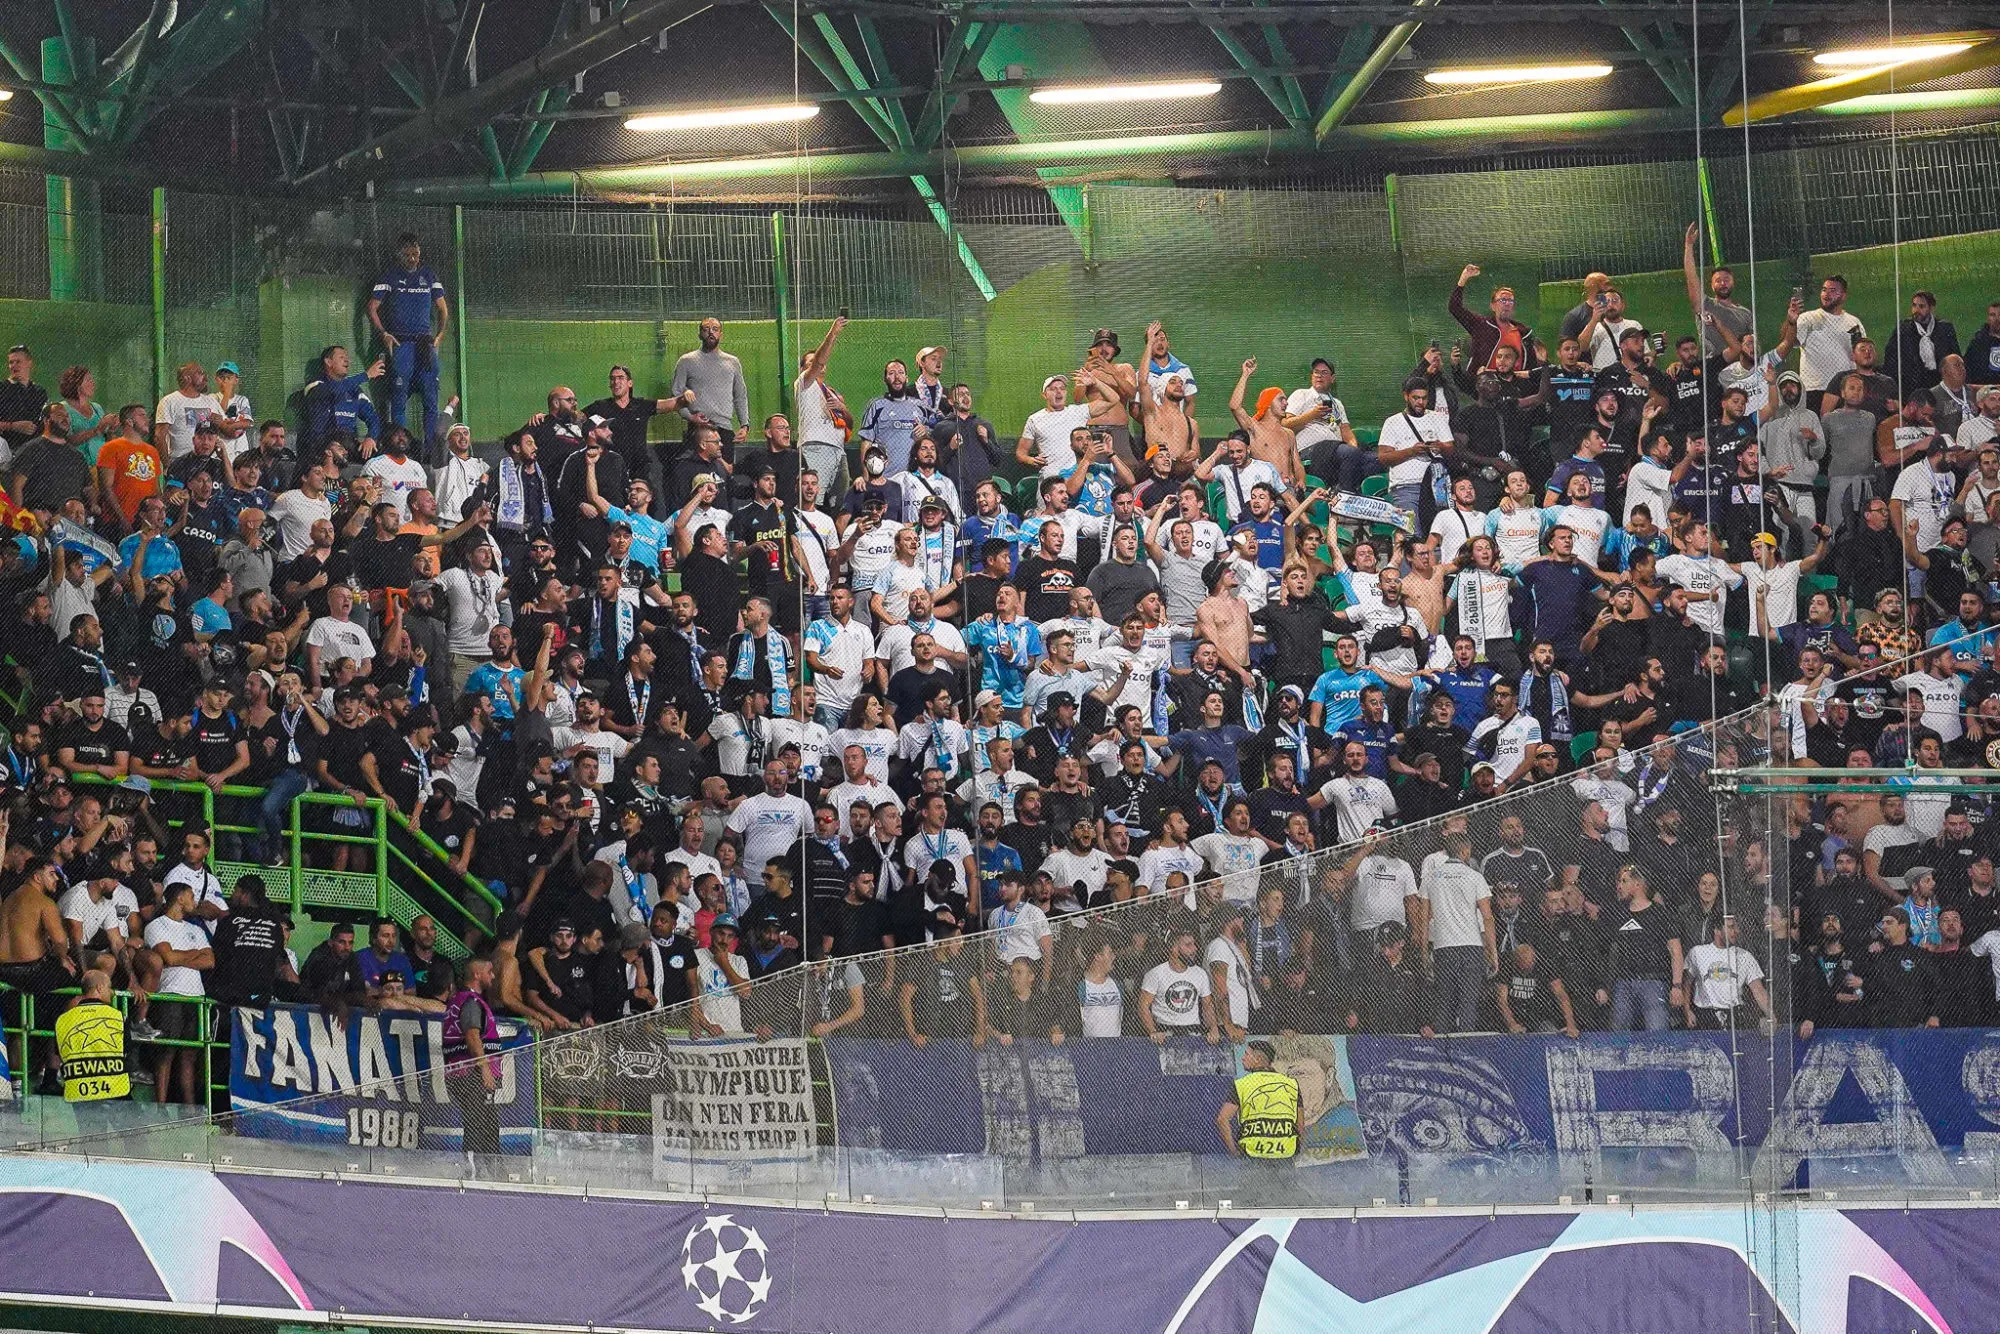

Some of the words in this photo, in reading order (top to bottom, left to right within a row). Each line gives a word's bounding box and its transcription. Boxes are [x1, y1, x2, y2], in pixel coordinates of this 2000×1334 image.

[1677, 381, 1698, 391] Uber
[1678, 388, 1701, 400] Eats
[1691, 572, 1713, 581] Uber
[1691, 581, 1712, 589] Eats
[1926, 694, 1958, 702] AZOO
[1498, 738, 1519, 746] Uber
[1498, 747, 1519, 756] Eats
[745, 1047, 804, 1066] NOTRE
[78, 1081, 111, 1096] 034
[677, 1068, 806, 1097] LYMPIQUE
[700, 1102, 743, 1125] N'EN
[749, 1101, 810, 1124] FERA
[349, 1107, 420, 1147] 1988
[1243, 1121, 1293, 1136] STEWAR
[1255, 1142, 1286, 1154] 424
